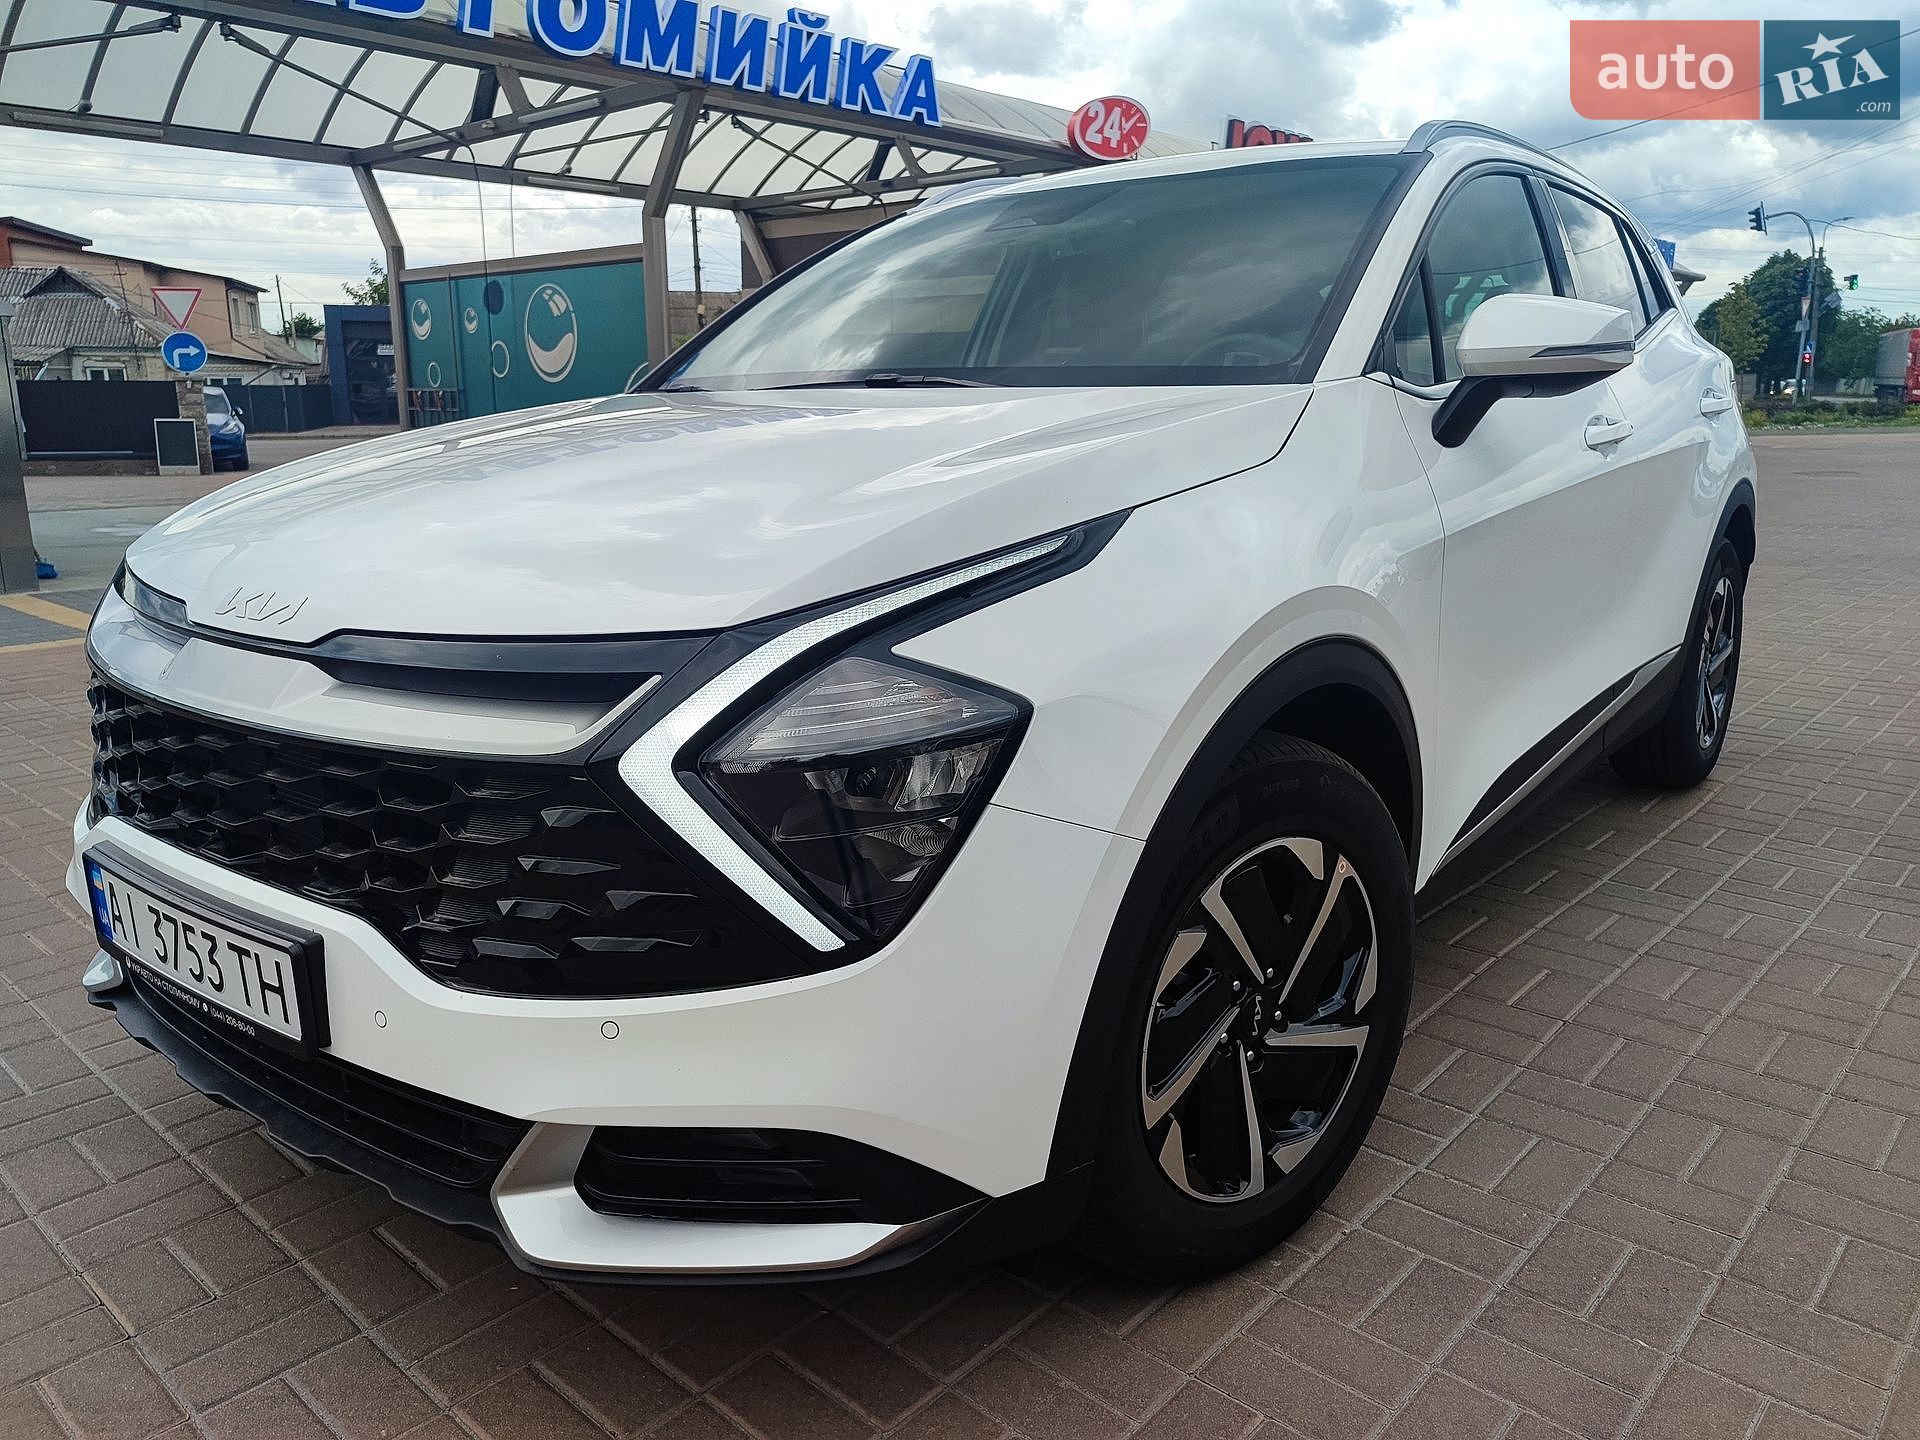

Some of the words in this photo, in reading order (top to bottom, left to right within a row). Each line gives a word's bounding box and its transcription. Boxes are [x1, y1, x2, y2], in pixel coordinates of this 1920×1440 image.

[303, 0, 945, 128] ОМИЙКА
[1085, 100, 1122, 149] 24
[98, 906, 111, 928] UA
[108, 881, 141, 950] AI
[147, 904, 225, 993] 3753
[226, 940, 291, 1025] TH
